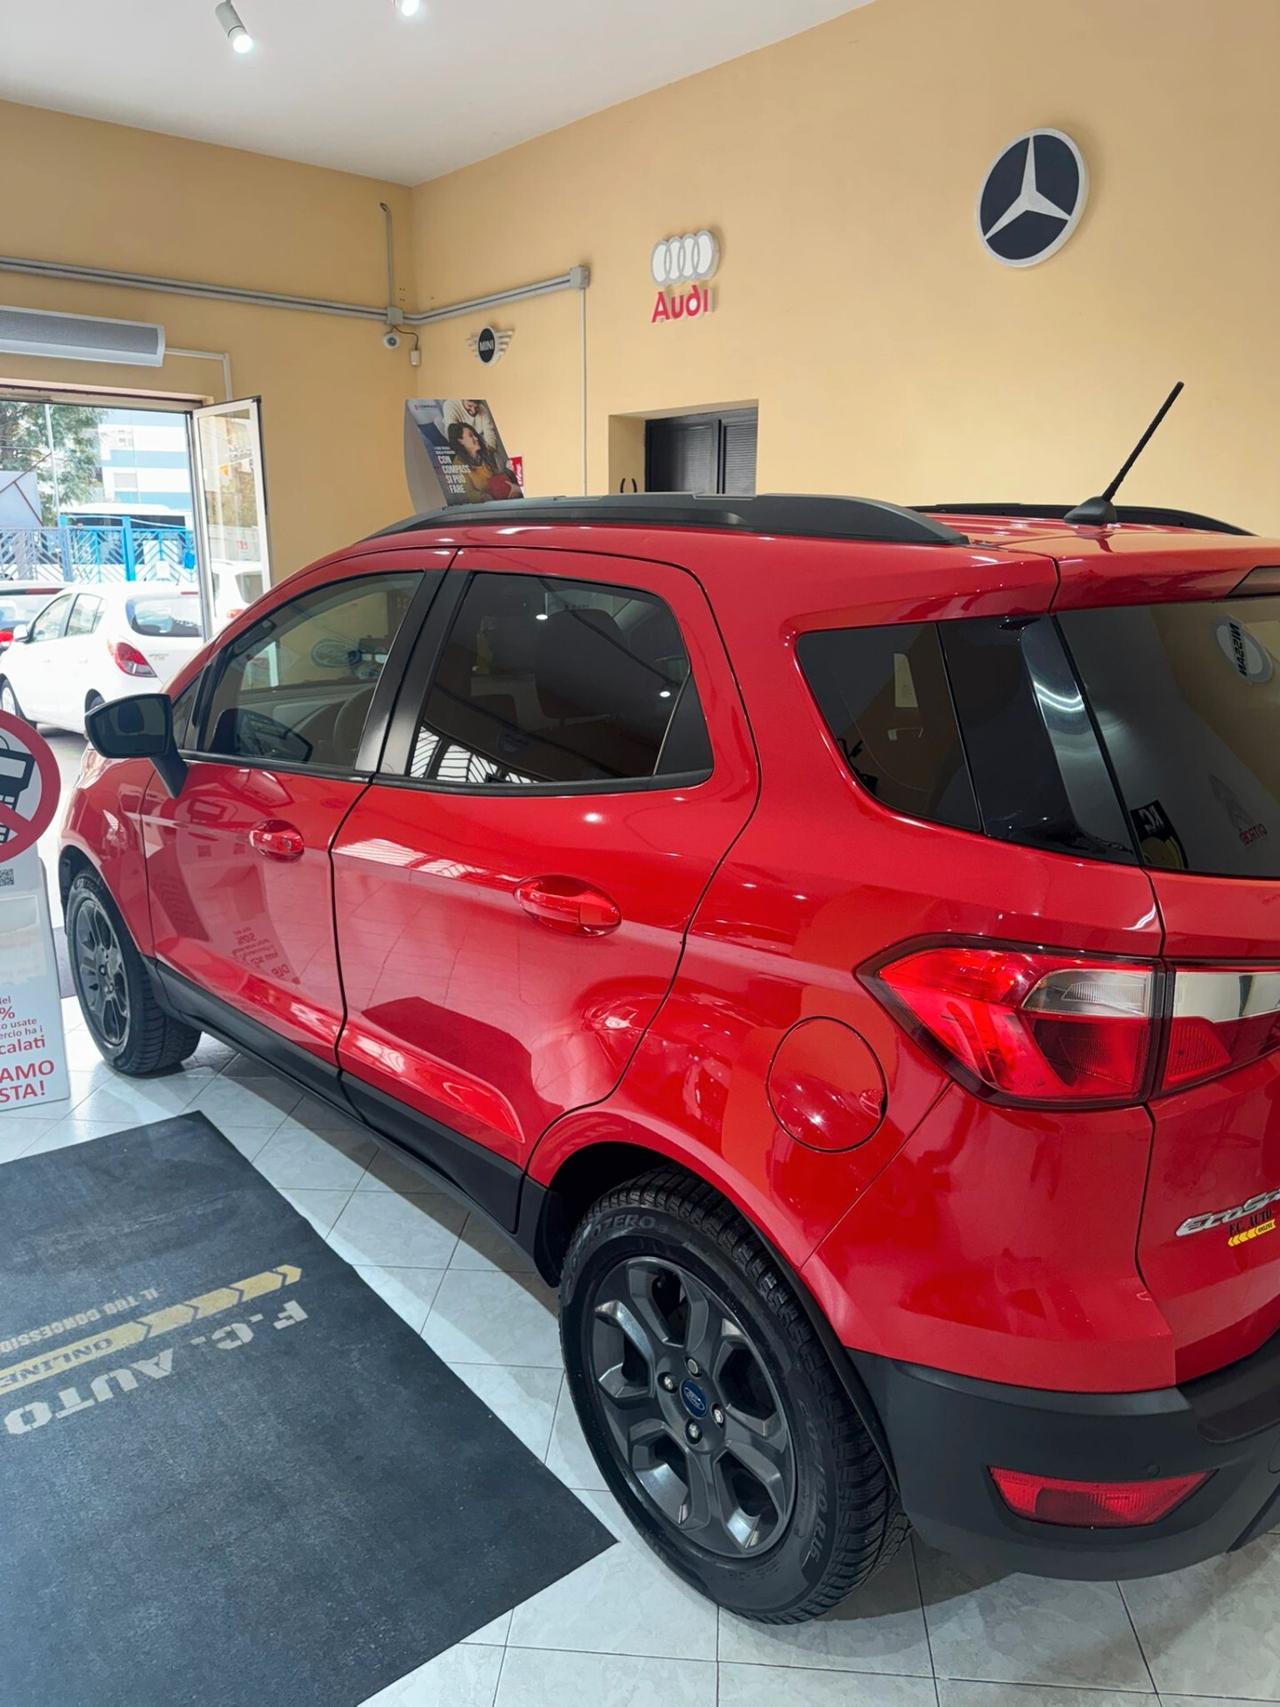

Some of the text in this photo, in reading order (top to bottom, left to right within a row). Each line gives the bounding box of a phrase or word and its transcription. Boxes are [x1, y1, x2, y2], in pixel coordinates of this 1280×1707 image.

[651, 284, 709, 323] Audi
[437, 455, 452, 465] CON
[10, 1018, 38, 1029] usate
[0, 1059, 55, 1084] AMO
[0, 1080, 46, 1104] STA!
[0, 1338, 114, 1388] ONLINE
[4, 1348, 174, 1435] AUTO
